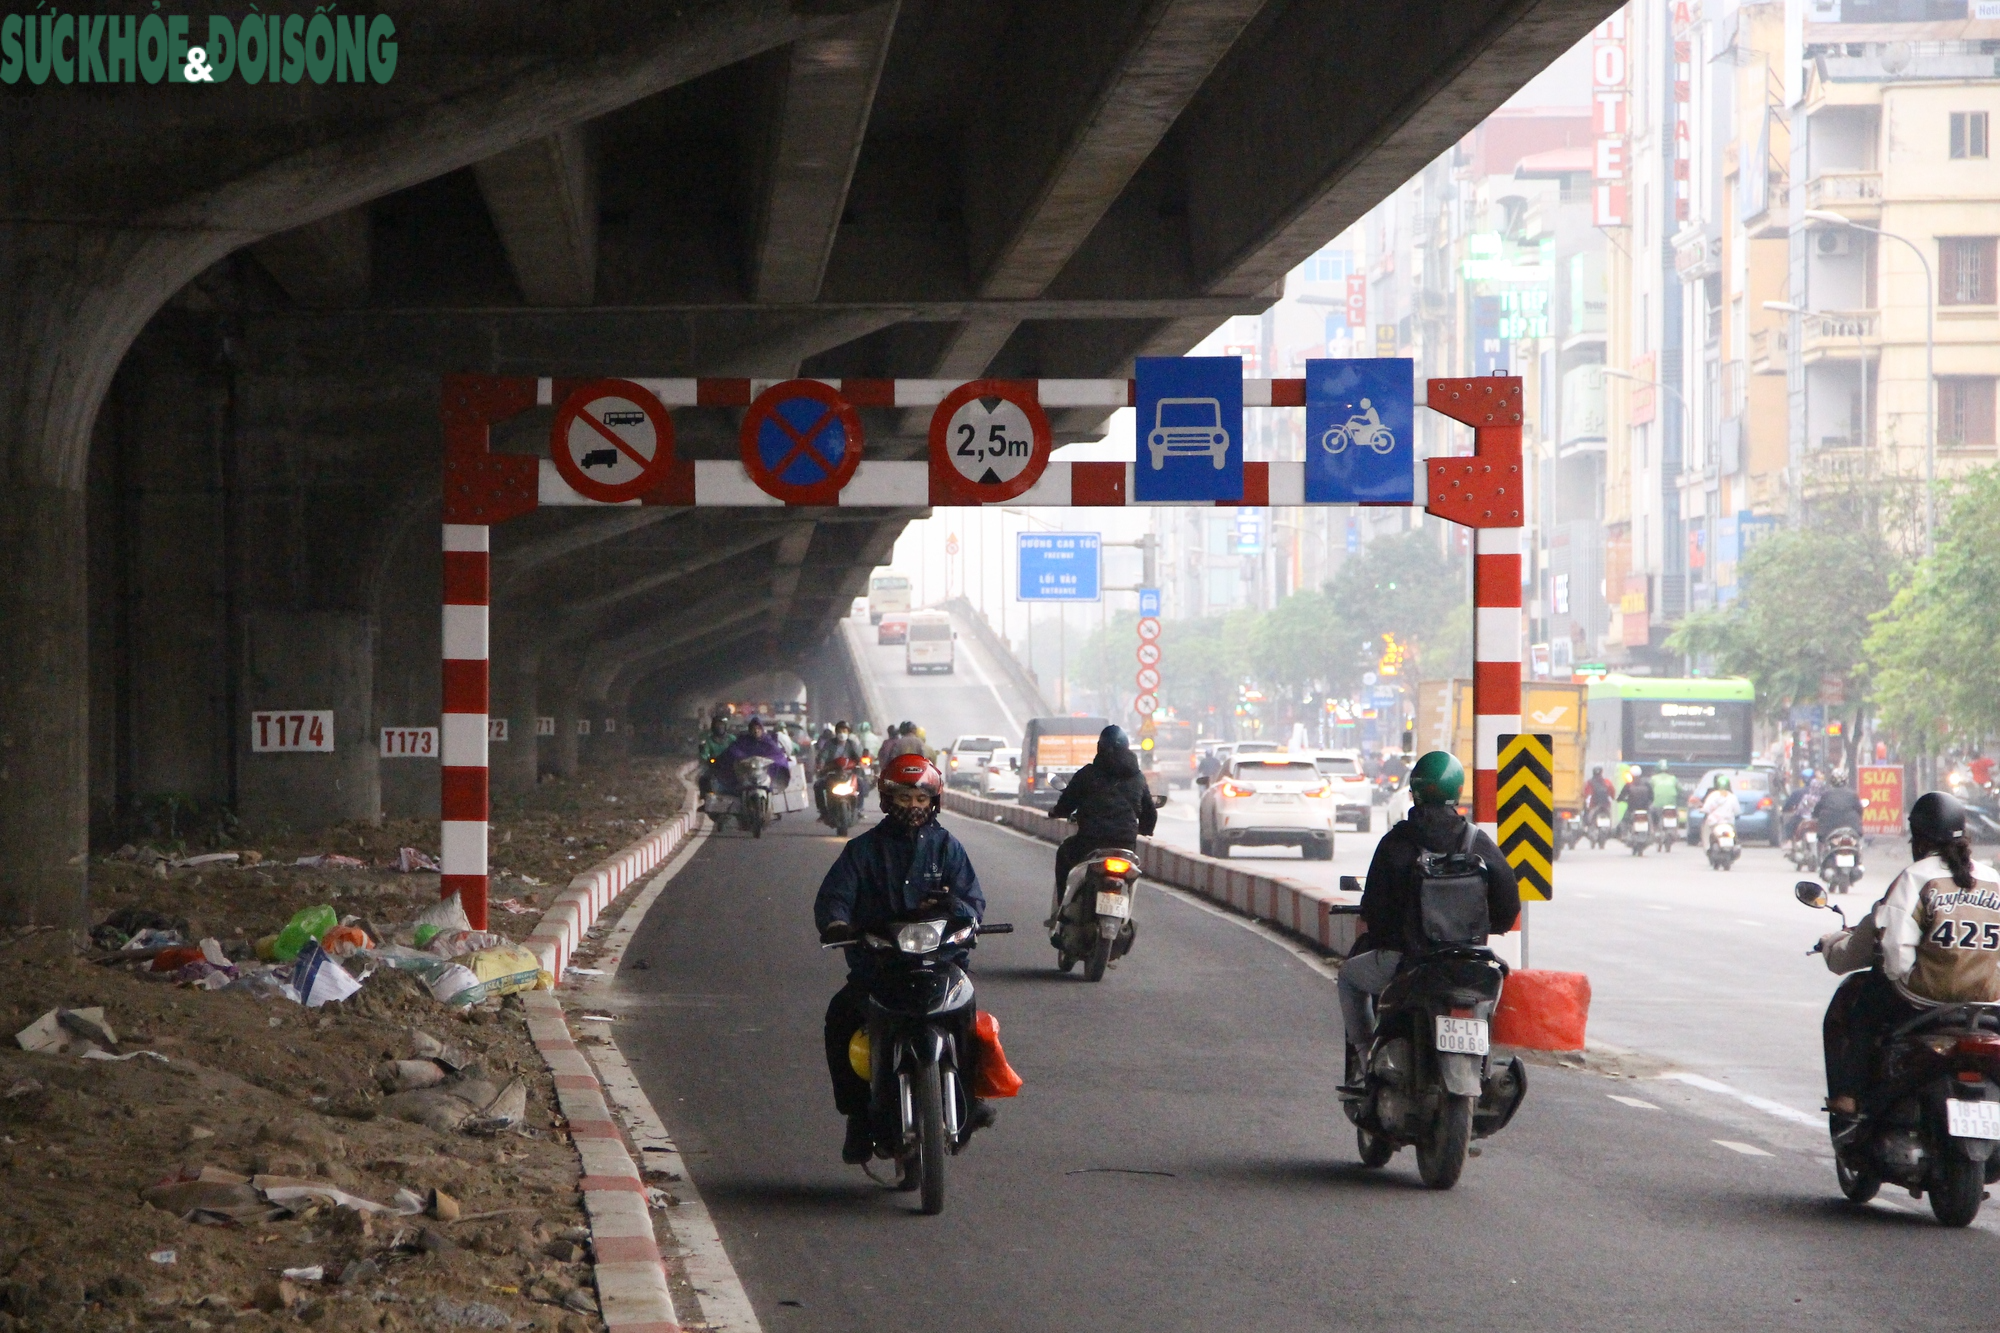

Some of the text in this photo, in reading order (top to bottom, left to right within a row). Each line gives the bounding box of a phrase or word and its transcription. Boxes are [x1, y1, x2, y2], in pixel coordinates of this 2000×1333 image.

[1349, 279, 1364, 323] TCL
[957, 423, 1028, 463] 2,5m
[257, 715, 324, 747] T174
[385, 731, 432, 753] T173
[1870, 788, 1891, 802] XE
[1863, 806, 1899, 821] MÁY
[1444, 1019, 1479, 1036] 34-L1
[1440, 1034, 1485, 1052] 008.68
[1956, 1102, 1993, 1120] 18-L1
